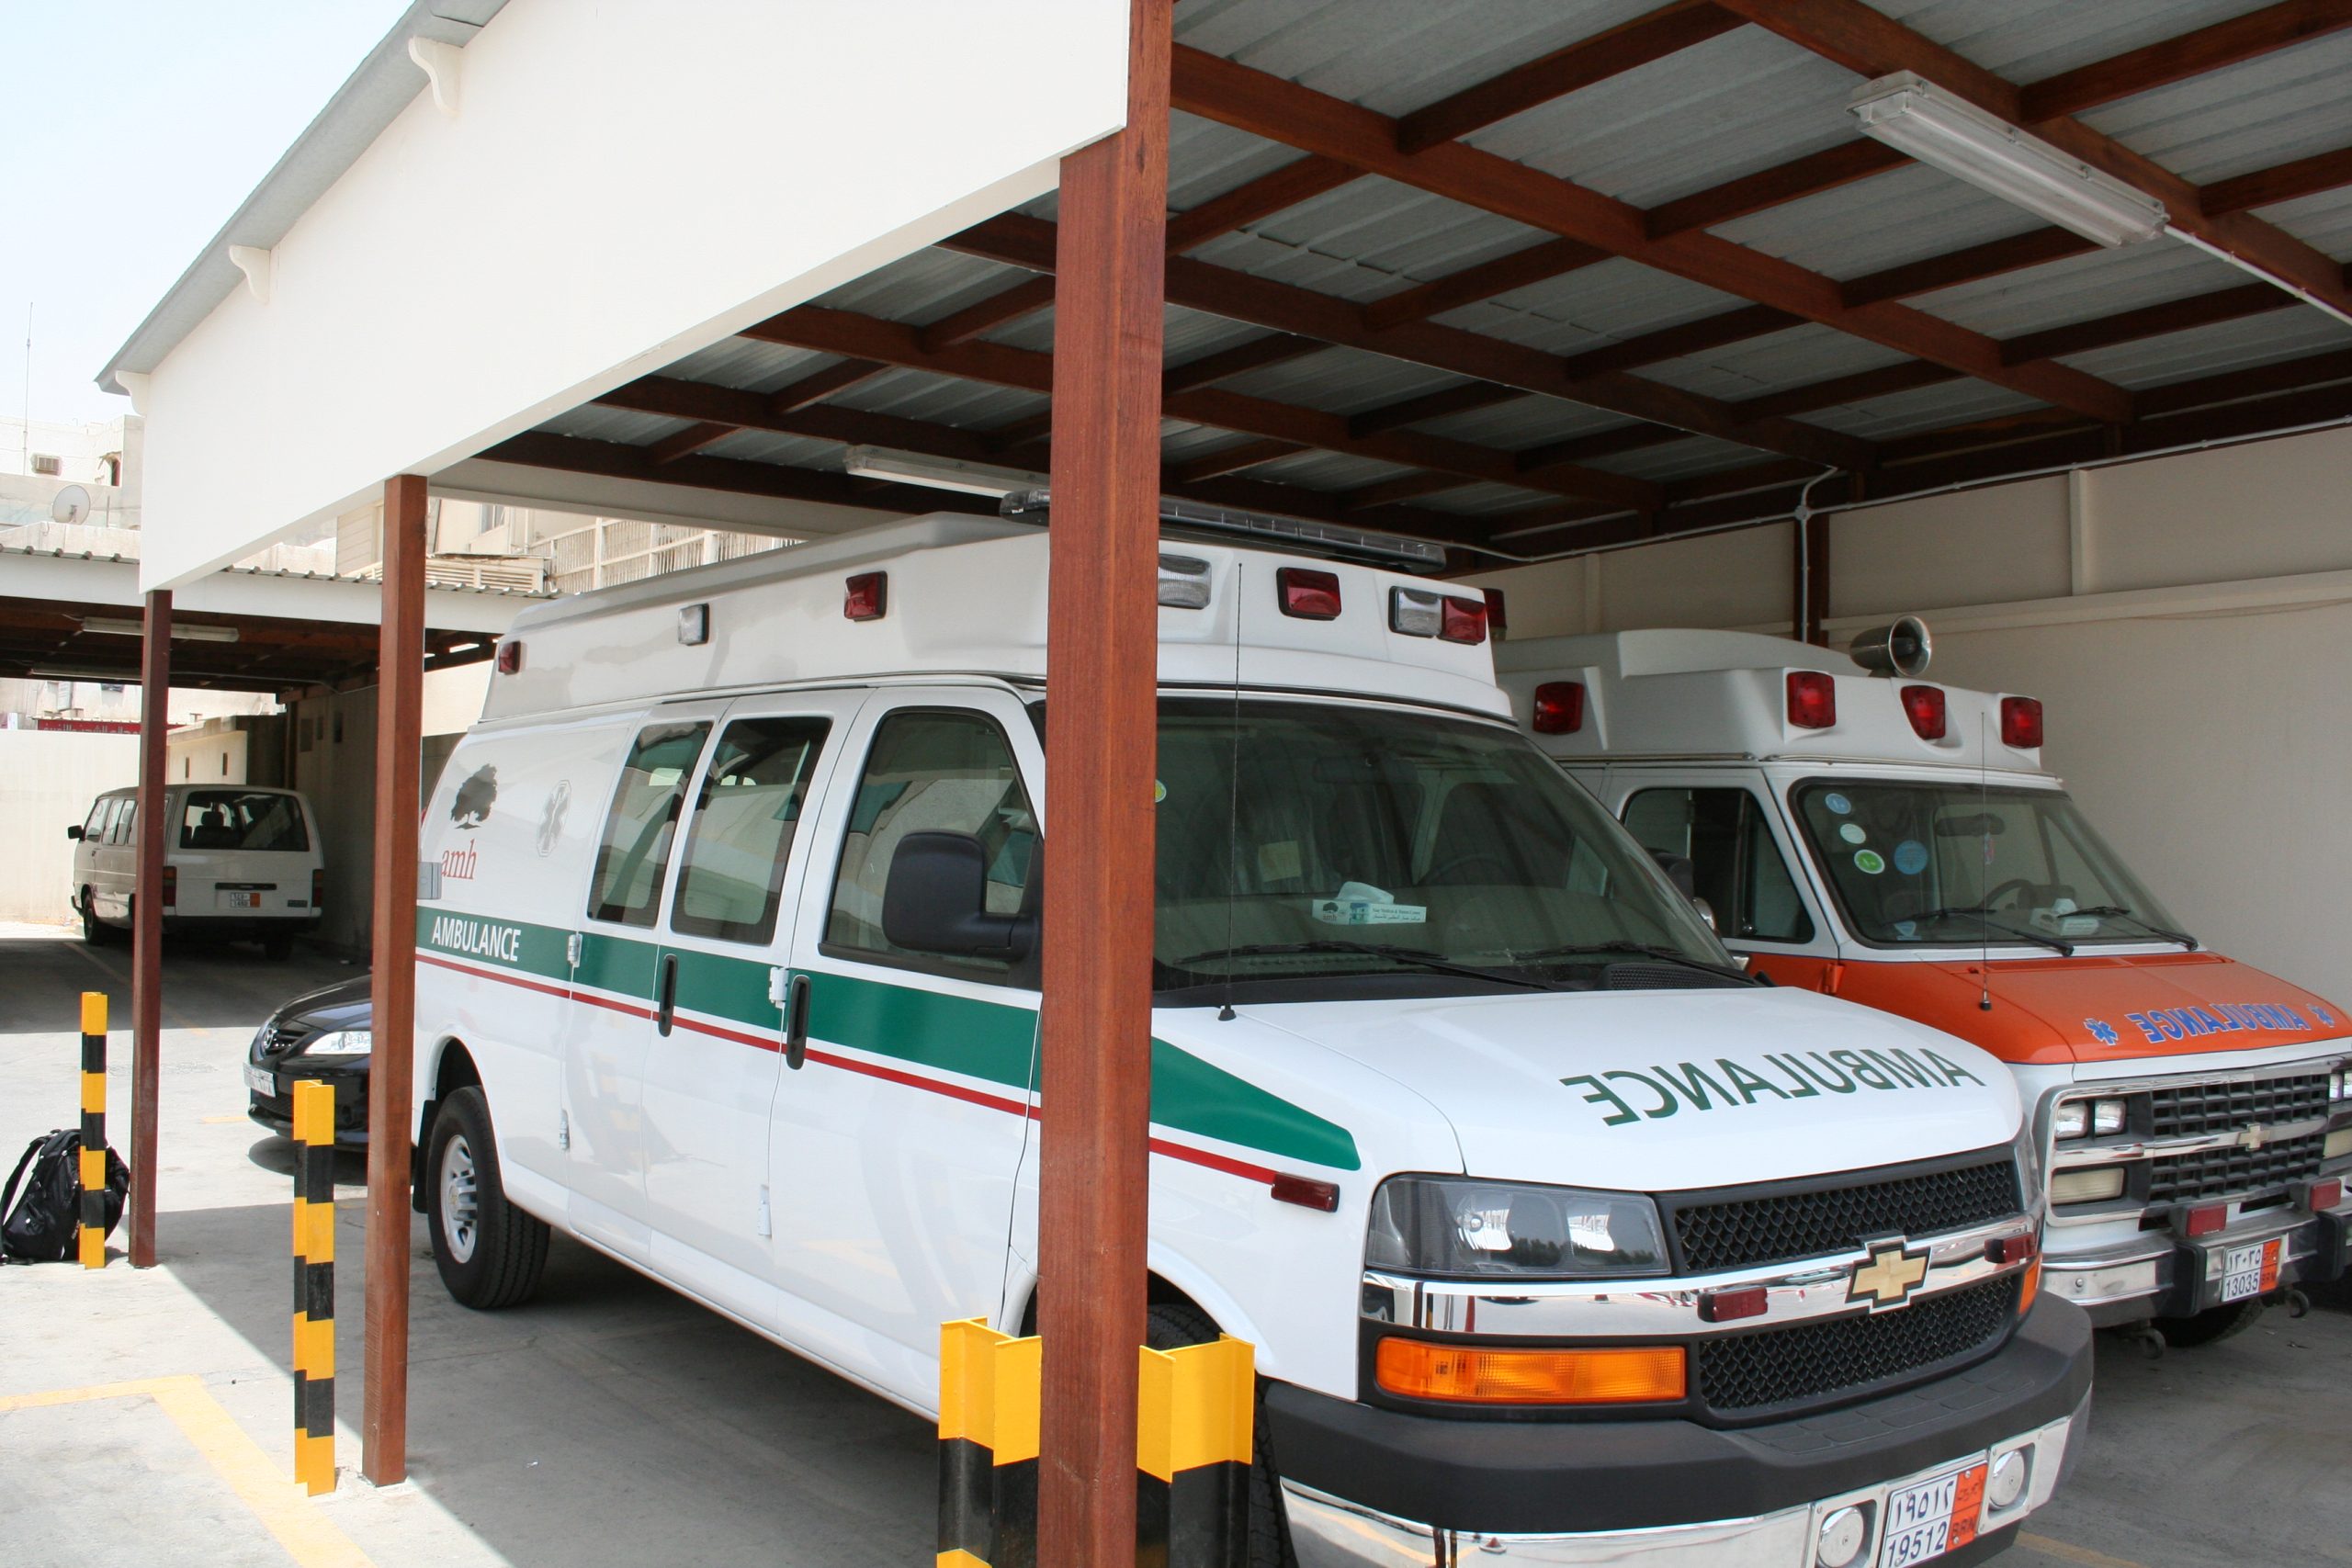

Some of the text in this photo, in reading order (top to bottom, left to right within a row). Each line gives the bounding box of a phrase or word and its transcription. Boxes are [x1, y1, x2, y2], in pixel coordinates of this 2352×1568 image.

[441, 838, 477, 879] amh
[431, 916, 521, 962] AMBULANCE
[2226, 1272, 2259, 1297] 13035
[1895, 1480, 1954, 1528] ١٩٥١٢
[1952, 1516, 1977, 1535] BRN
[1888, 1521, 1947, 1567] 19512
